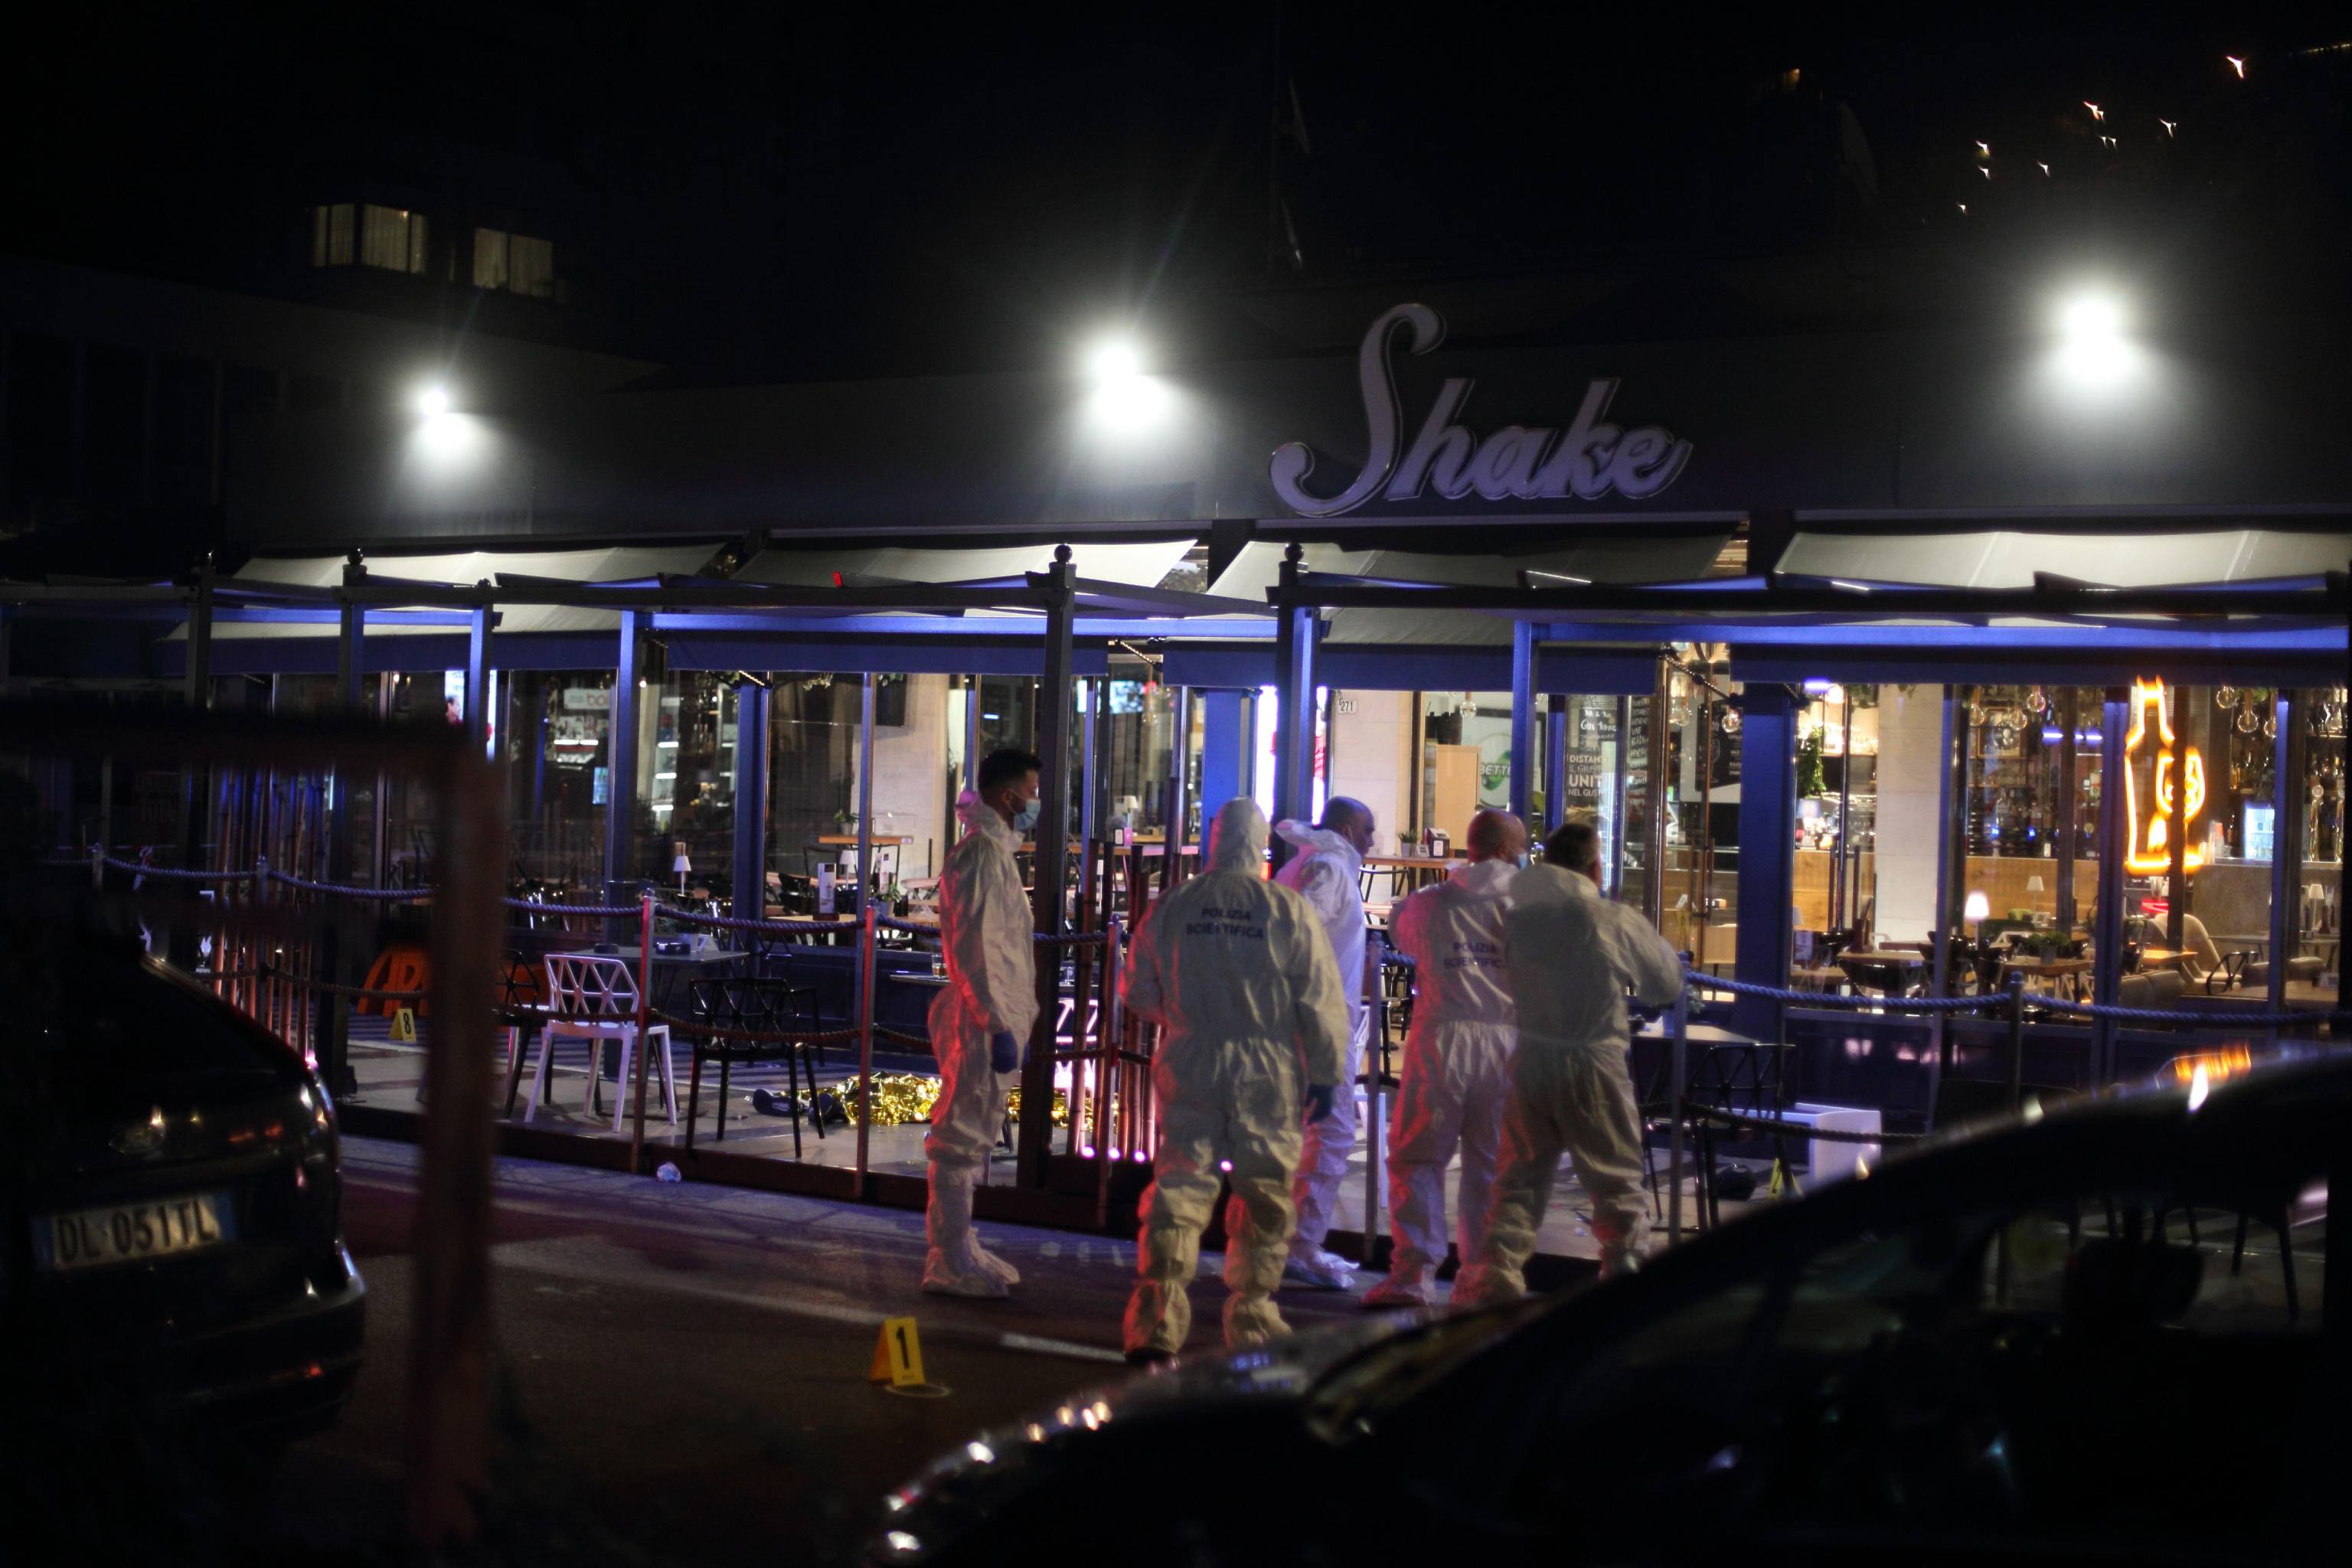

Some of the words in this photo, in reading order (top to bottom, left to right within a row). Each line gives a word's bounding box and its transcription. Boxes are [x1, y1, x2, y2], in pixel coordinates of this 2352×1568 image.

[1269, 302, 1694, 518] Shake
[1341, 701, 1354, 712] 271
[1569, 754, 1606, 764] DISTAN
[1569, 773, 1606, 788] UNIT
[1583, 789, 1605, 797] GUST
[1201, 907, 1251, 920] POLIZIA
[403, 1012, 412, 1034] 8
[57, 1212, 101, 1263] DL
[896, 1326, 910, 1369] 1
